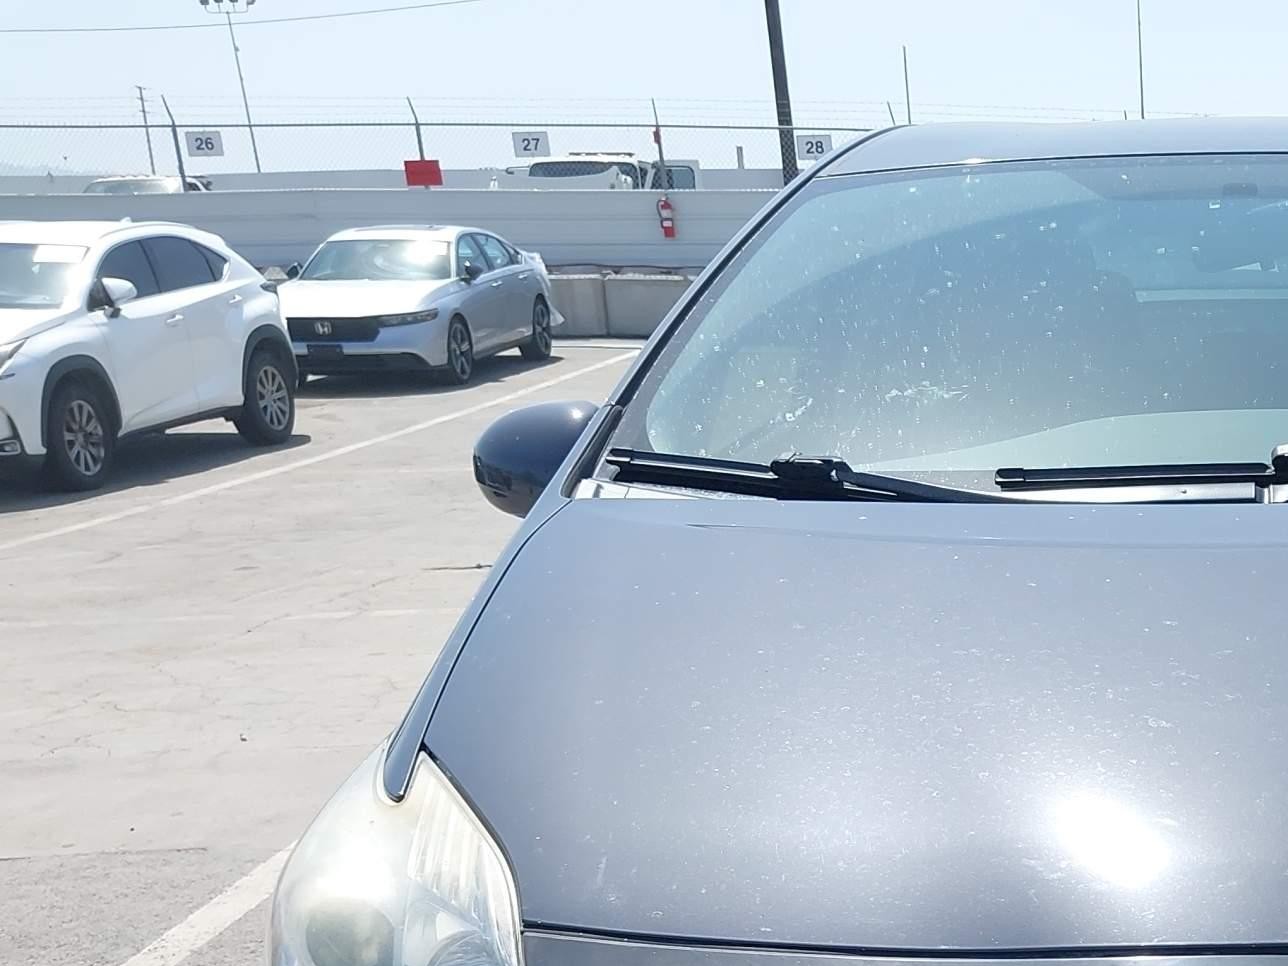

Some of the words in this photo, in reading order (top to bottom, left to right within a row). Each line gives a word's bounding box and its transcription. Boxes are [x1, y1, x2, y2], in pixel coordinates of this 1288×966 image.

[194, 137, 214, 151] 26
[522, 137, 540, 152] 27
[805, 140, 825, 154] 28
